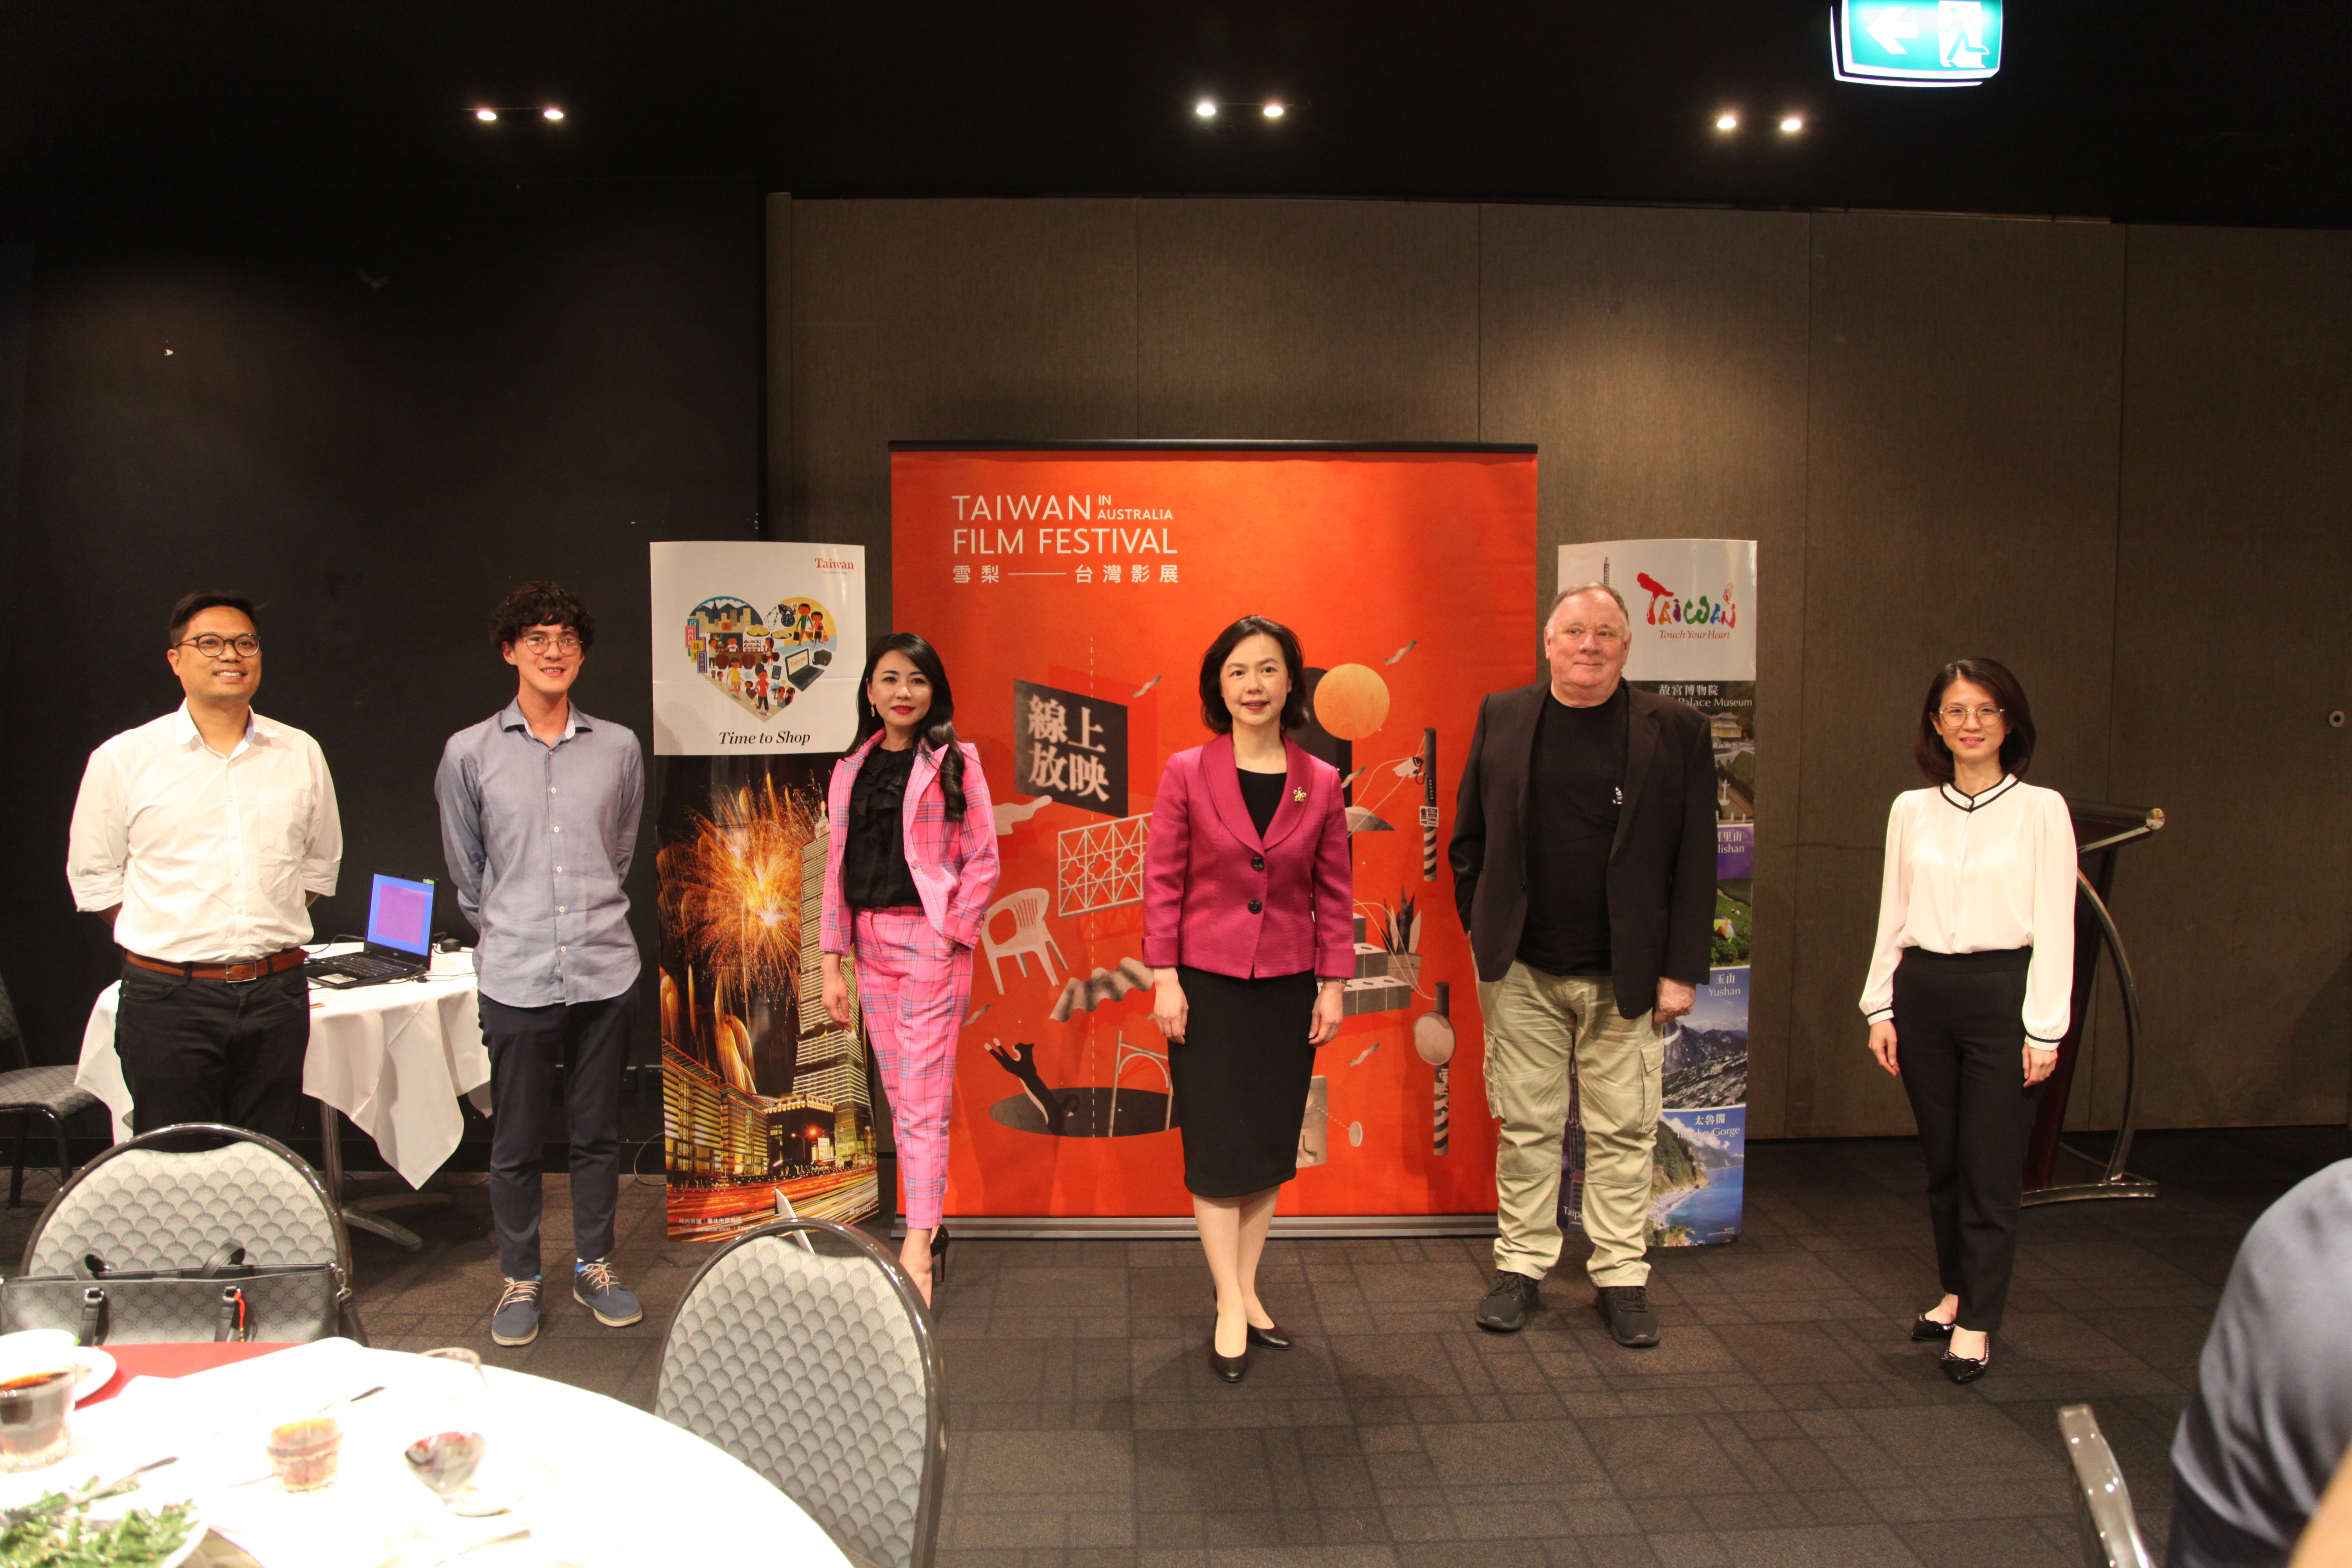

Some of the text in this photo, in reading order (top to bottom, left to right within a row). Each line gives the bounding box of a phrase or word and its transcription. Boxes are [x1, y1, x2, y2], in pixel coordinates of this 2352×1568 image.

[1098, 495, 1111, 505] IN
[952, 495, 1091, 521] TAIWAN
[1097, 509, 1173, 520] AUSTRALIA
[954, 528, 1178, 554] FILM FESTIVAL
[814, 557, 854, 569] Taiwan
[953, 564, 1179, 583] 雪梨 台灣影展
[1659, 630, 1685, 638] Touch
[1659, 684, 1718, 696] 故宮博物院
[1714, 698, 1752, 707] Museum
[1027, 694, 1106, 752] 線上
[719, 730, 810, 746] Time to Shop
[1028, 741, 1110, 802] 放映
[1718, 843, 1745, 854] lishan
[1716, 973, 1735, 984] 玉山
[1709, 986, 1741, 997] Yushan
[1713, 1127, 1741, 1137] Gorge
